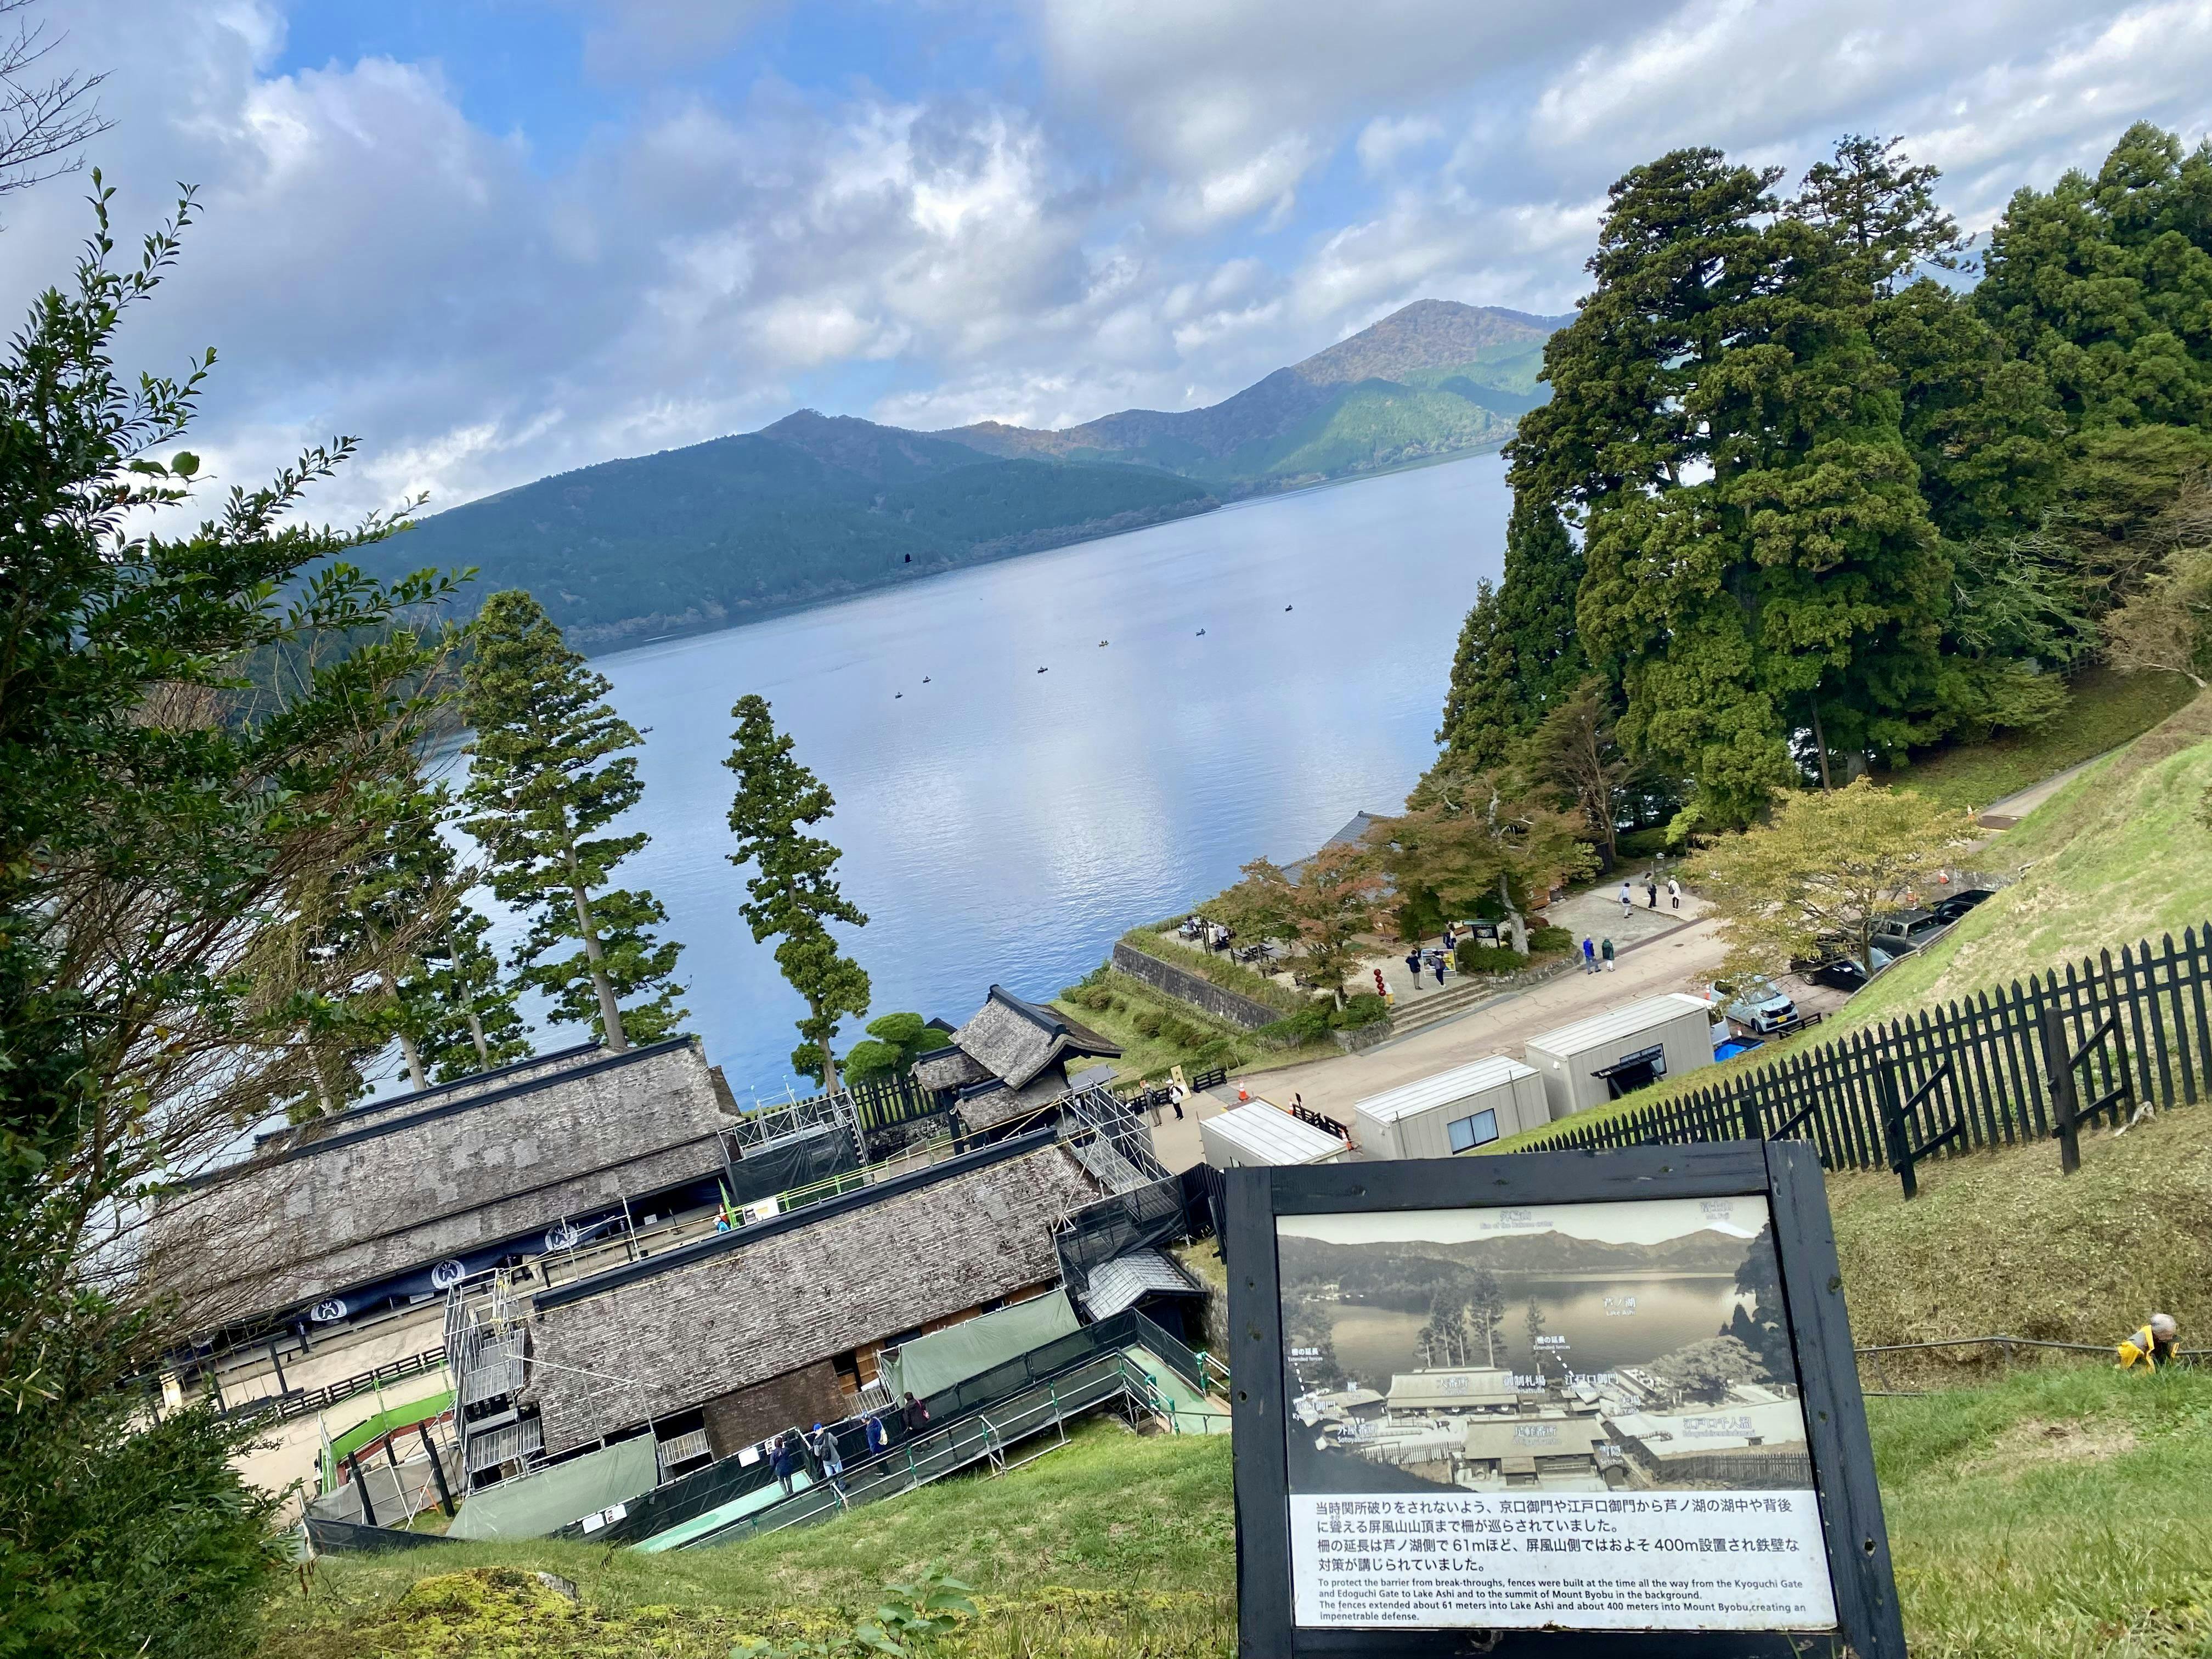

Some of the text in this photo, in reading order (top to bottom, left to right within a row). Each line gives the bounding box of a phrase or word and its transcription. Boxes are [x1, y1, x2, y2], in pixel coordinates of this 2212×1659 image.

[1318, 1558, 1484, 1572] 対策が講じられていました。
[1318, 1578, 1328, 1587] To
[1332, 1578, 1362, 1588] protect
[1364, 1578, 1378, 1587] the
[1381, 1578, 1409, 1587] barrier
[1413, 1578, 1432, 1587] from
[1508, 1578, 1536, 1587] fences
[1564, 1579, 1583, 1587] built
[1598, 1579, 1612, 1587] the
[1616, 1579, 1635, 1587] time
[1692, 1579, 1713, 1588] from
[1735, 1580, 1777, 1589] Kyoguchi
[1781, 1580, 1802, 1588] Gate
[1319, 1589, 1334, 1598] and
[1338, 1589, 1376, 1600] Edoguchi
[1413, 1590, 1433, 1598] Lake
[1436, 1590, 1454, 1598] Ashi
[1457, 1590, 1473, 1598] and
[1488, 1590, 1502, 1598] the
[1541, 1590, 1549, 1598] of
[1585, 1591, 1613, 1600] Byobu
[1628, 1590, 1642, 1599] the
[1645, 1591, 1701, 1601] background.
[1320, 1601, 1335, 1609] The
[1339, 1600, 1366, 1609] fences
[1369, 1601, 1410, 1609] extended
[1413, 1601, 1440, 1609] about
[1534, 1602, 1553, 1610] Ashi
[1557, 1602, 1573, 1610] and
[1577, 1602, 1604, 1610] about
[1320, 1612, 1419, 1622] impenetrable defense.
